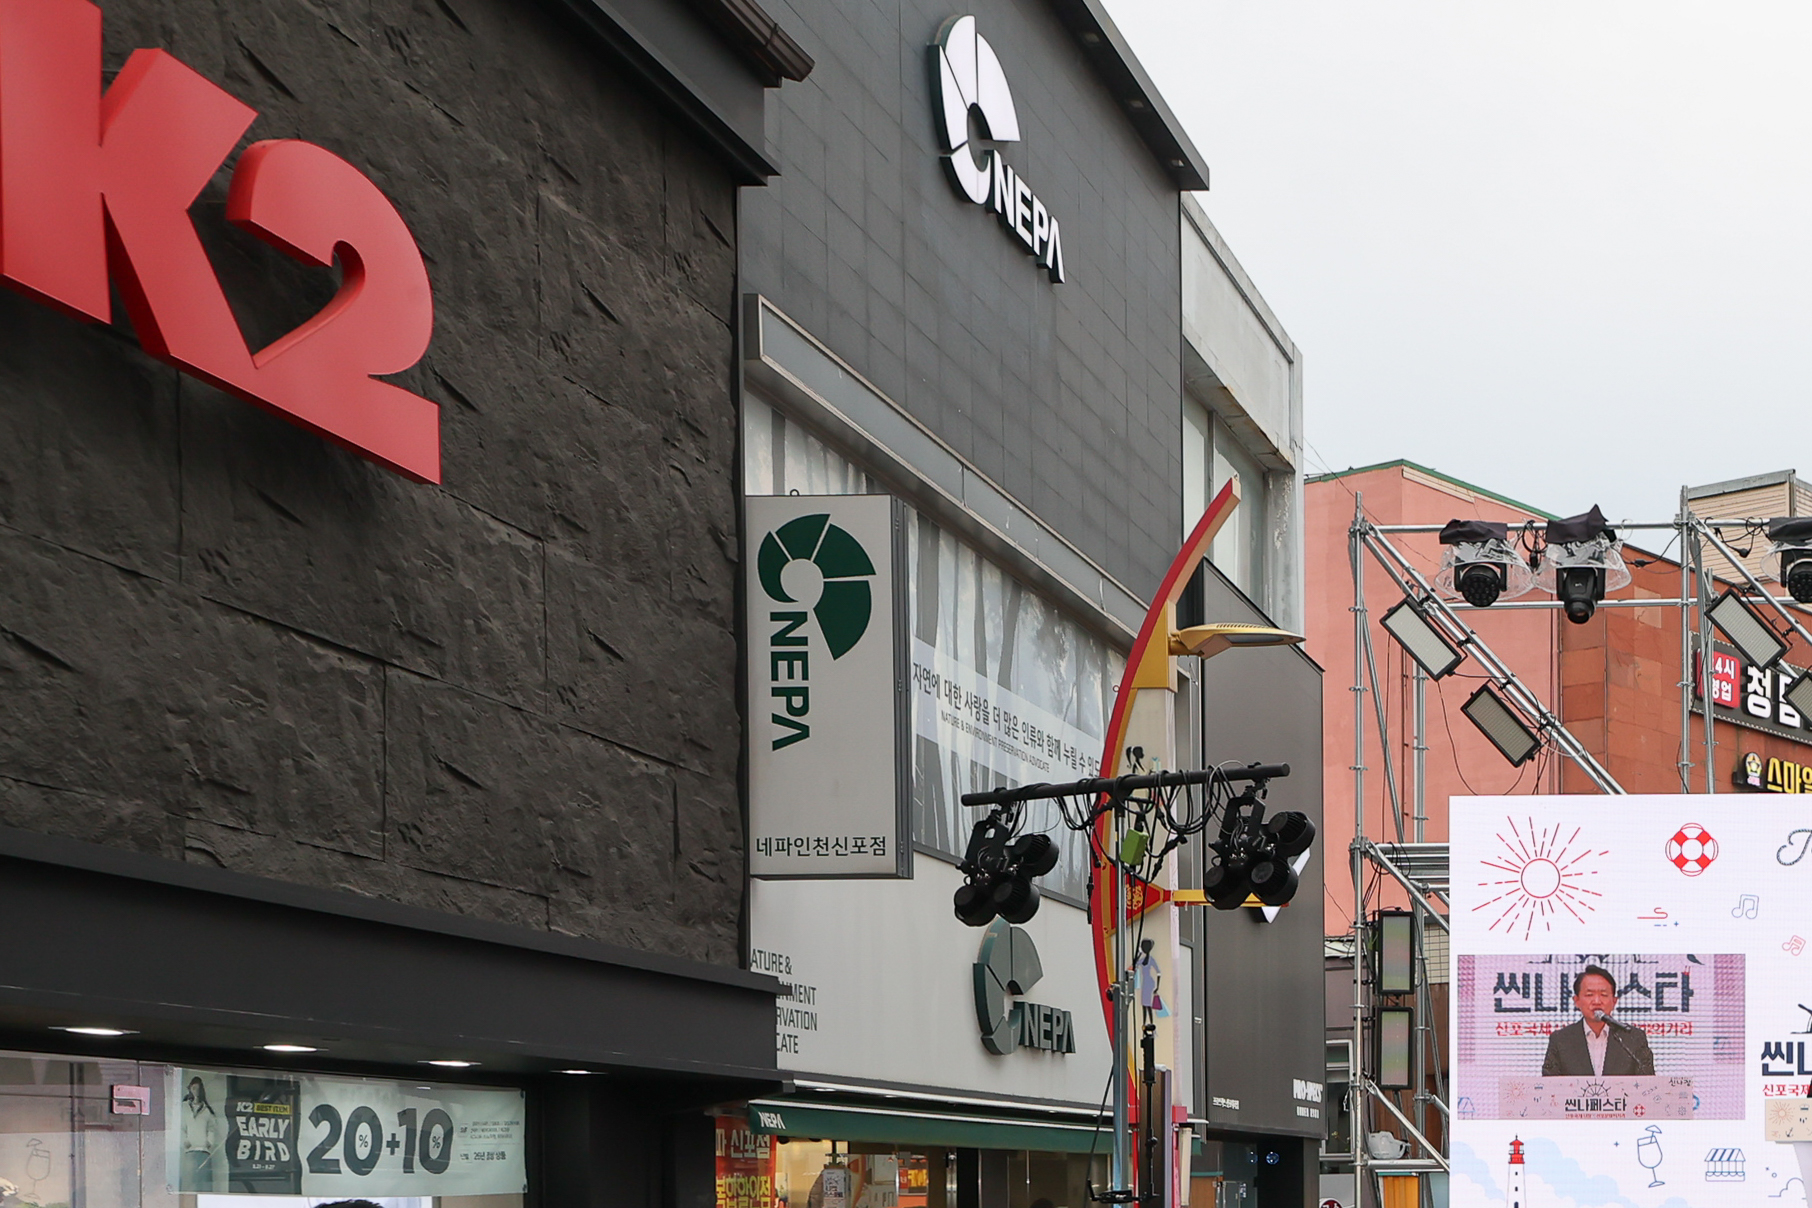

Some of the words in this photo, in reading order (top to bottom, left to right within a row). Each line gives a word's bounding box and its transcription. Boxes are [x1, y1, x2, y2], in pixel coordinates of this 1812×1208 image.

[994, 149, 1065, 284] NEPA
[0, 0, 441, 485] K2
[769, 611, 811, 752] NEPA
[1713, 656, 1736, 680] 4시
[912, 662, 941, 700] 자연에
[944, 679, 962, 711] 대한
[964, 691, 990, 726] 사랑을
[992, 706, 1001, 732] 더
[1003, 710, 1019, 741] 많은
[1021, 721, 1045, 752] 인류와
[1046, 734, 1062, 762] 함께
[1063, 743, 1078, 771] 누릴
[1078, 752, 1086, 774] 수
[756, 836, 887, 857] 네파인천신포점
[750, 948, 783, 974] ATURE
[785, 955, 792, 976] &
[1493, 971, 1695, 1013] 씬나스타
[1020, 1001, 1076, 1054] NEPA
[236, 1116, 290, 1139] EARLY
[758, 1111, 786, 1130] NEPA
[237, 1139, 291, 1162] BIRD
